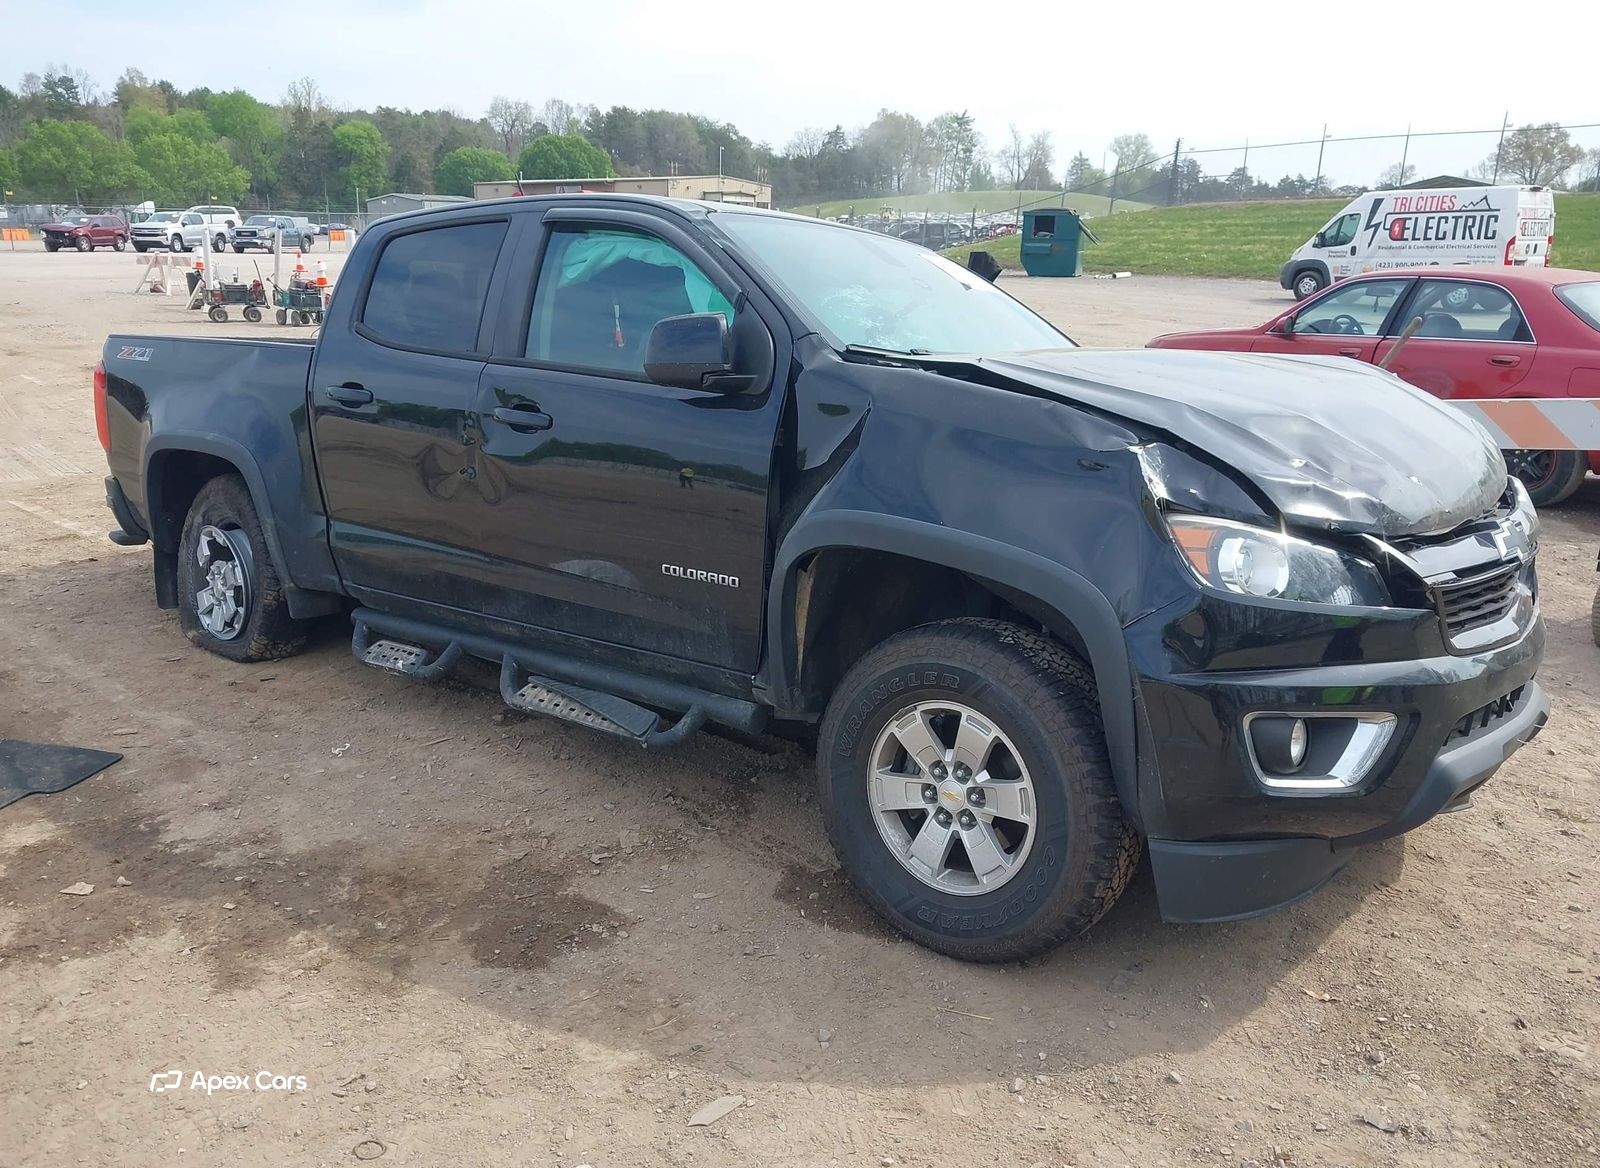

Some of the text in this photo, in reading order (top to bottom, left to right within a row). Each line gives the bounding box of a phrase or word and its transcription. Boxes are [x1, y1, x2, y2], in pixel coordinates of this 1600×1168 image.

[1393, 195, 1457, 212] TRI CITIES
[1389, 215, 1499, 241] ELECTRIC
[117, 345, 154, 362] Z71
[661, 563, 740, 588] COLORADO
[838, 671, 960, 758] WRANGLER
[916, 846, 1056, 931] GOODYEAR
